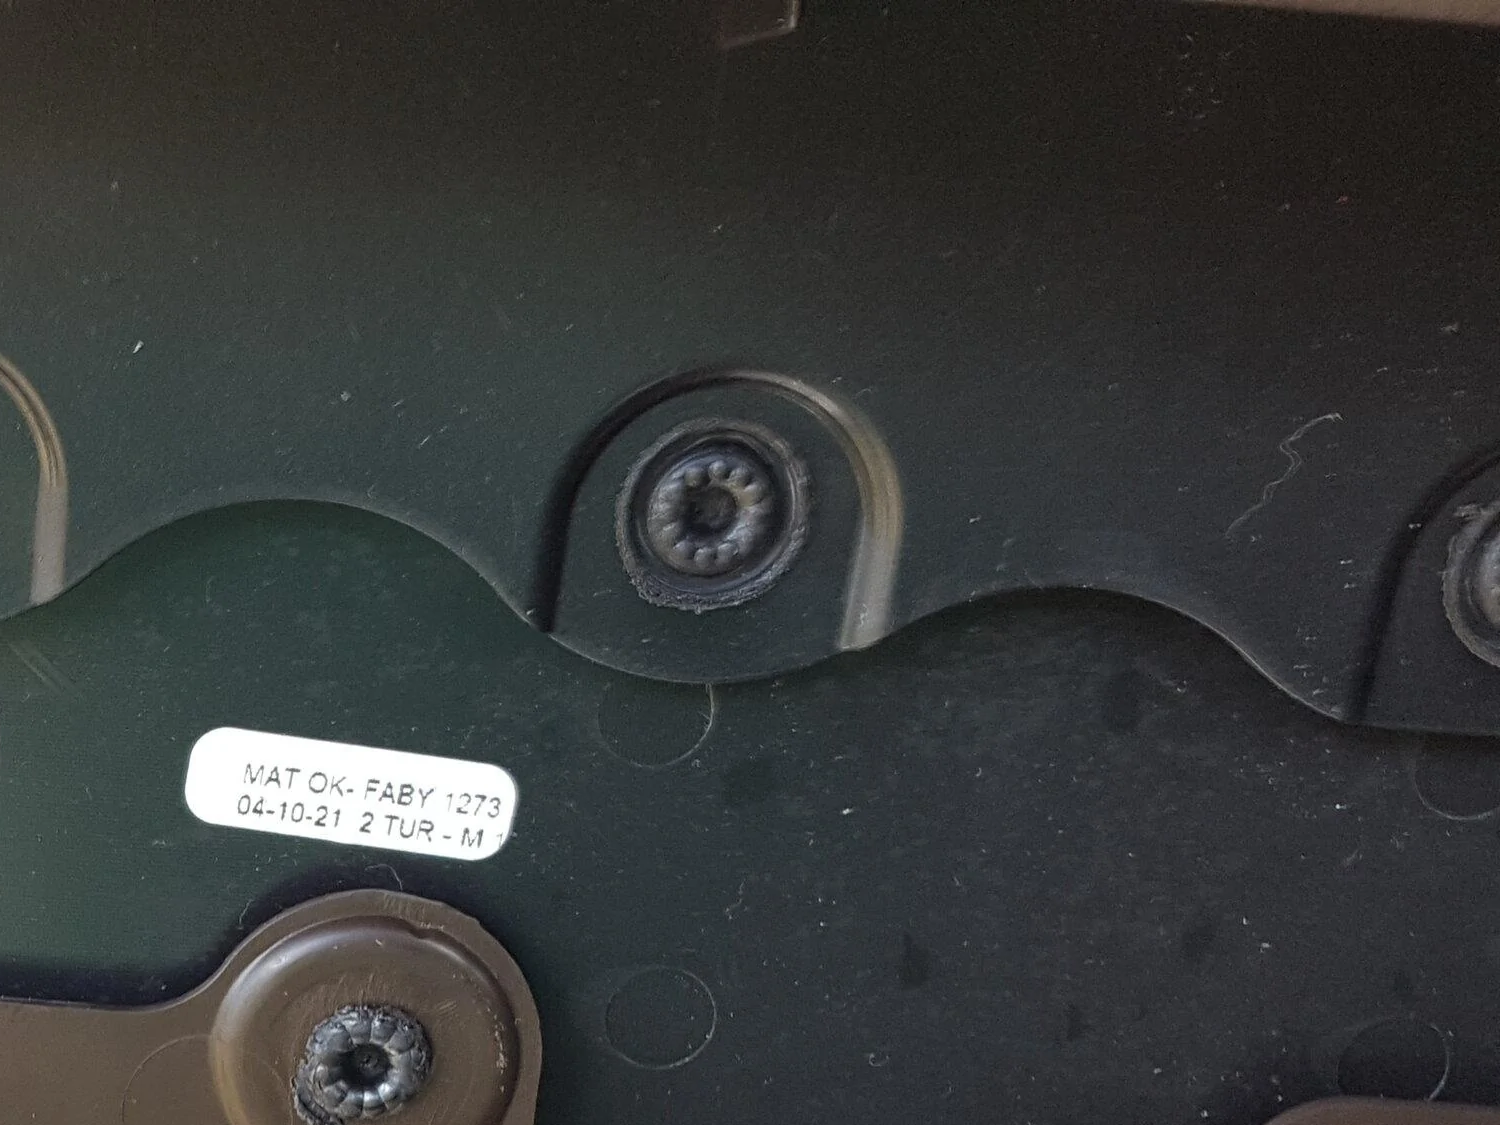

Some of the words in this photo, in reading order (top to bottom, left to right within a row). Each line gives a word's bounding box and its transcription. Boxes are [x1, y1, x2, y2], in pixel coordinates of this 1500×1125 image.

[244, 763, 301, 789] MAT
[365, 779, 434, 809] FABY
[446, 792, 501, 819] 1273
[238, 794, 341, 828] 04-10-21
[360, 811, 374, 834] 2
[385, 814, 434, 842] TUR
[461, 827, 484, 848] M
